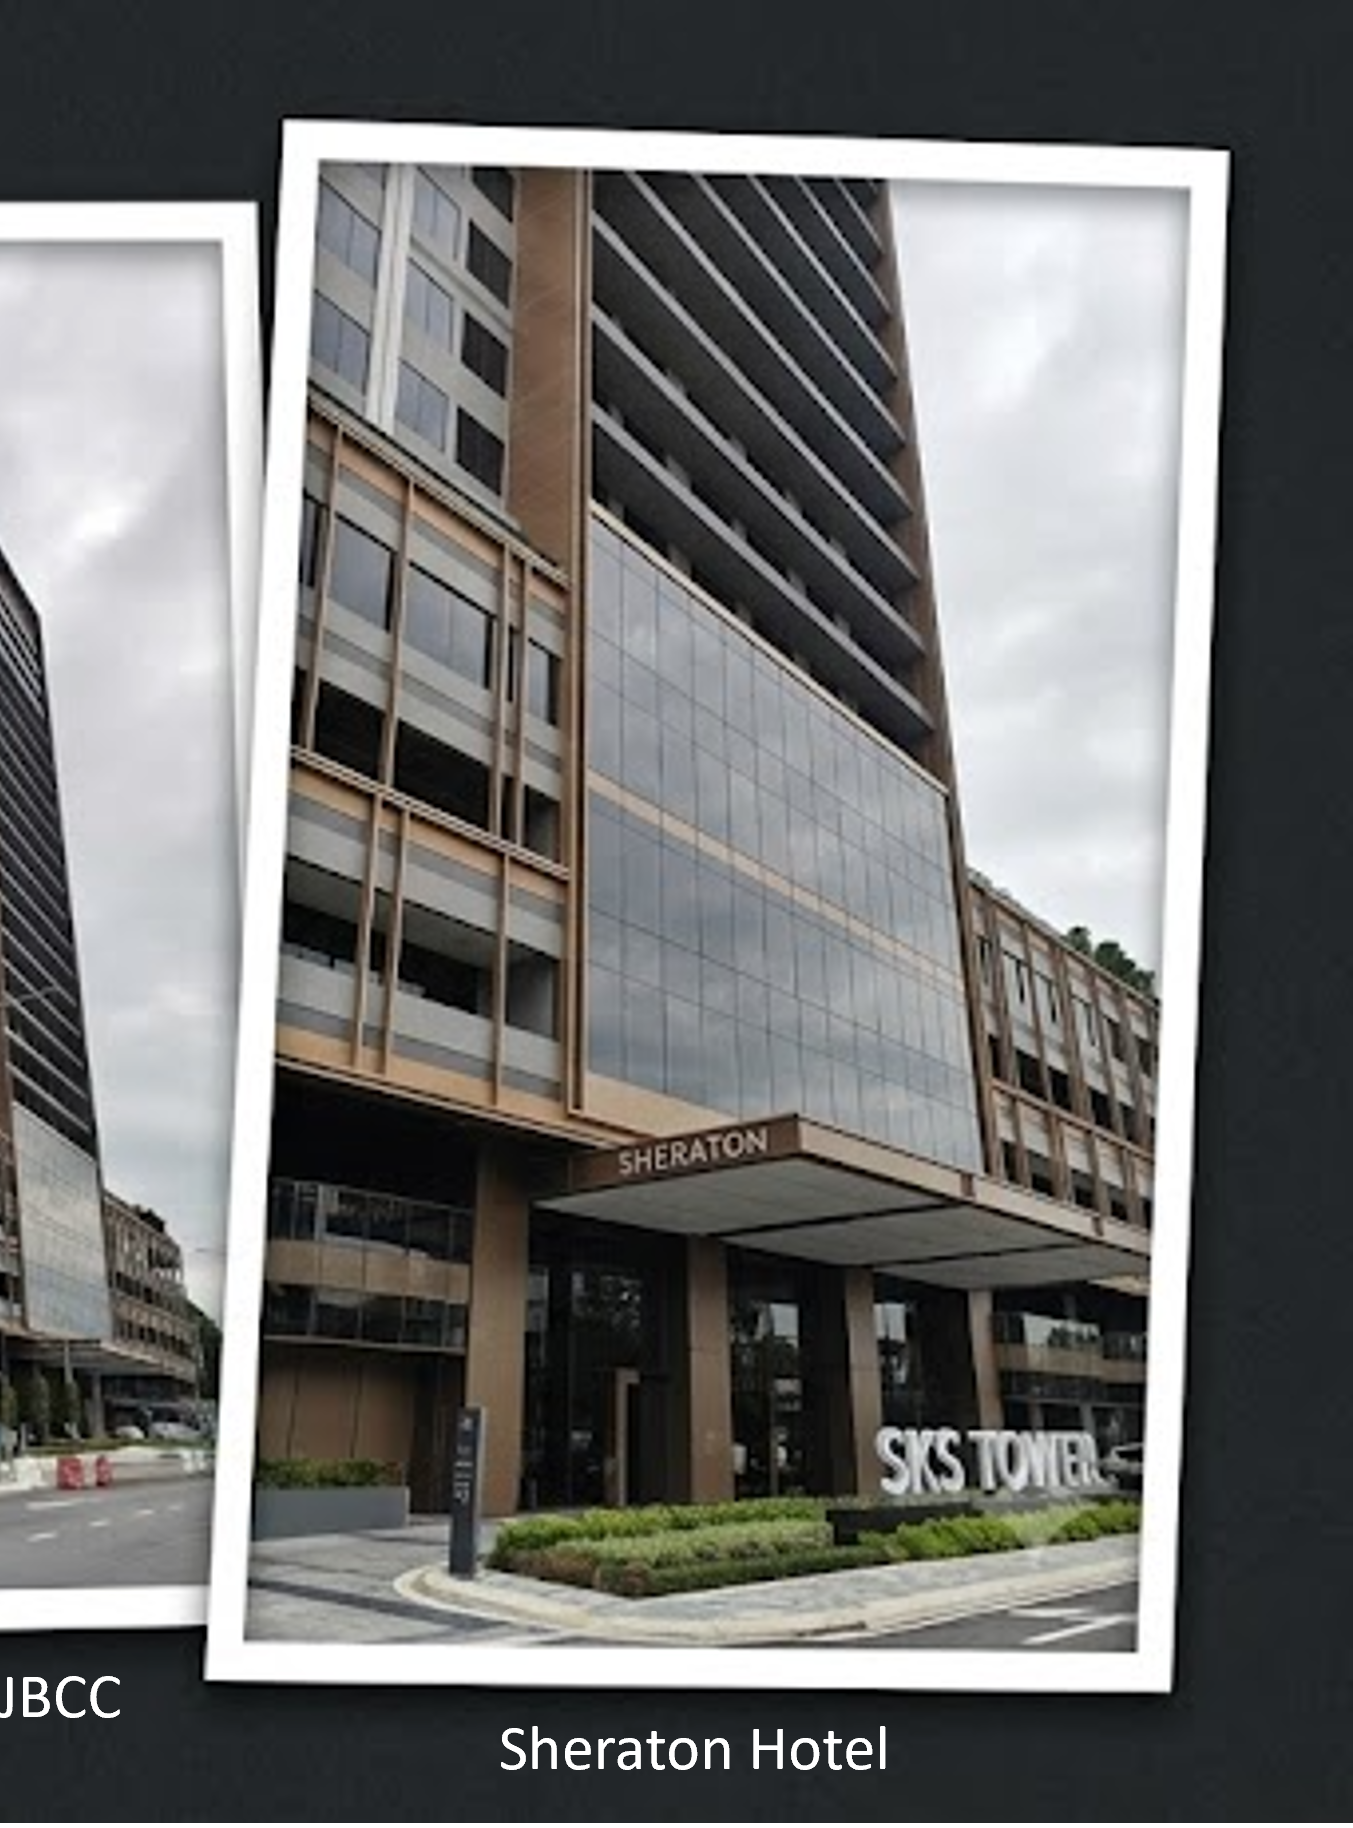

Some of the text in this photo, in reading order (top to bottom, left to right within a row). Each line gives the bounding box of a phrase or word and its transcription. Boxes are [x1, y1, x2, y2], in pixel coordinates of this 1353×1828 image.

[619, 1127, 769, 1175] SHERATON
[877, 1427, 1116, 1494] SKS TOWER
